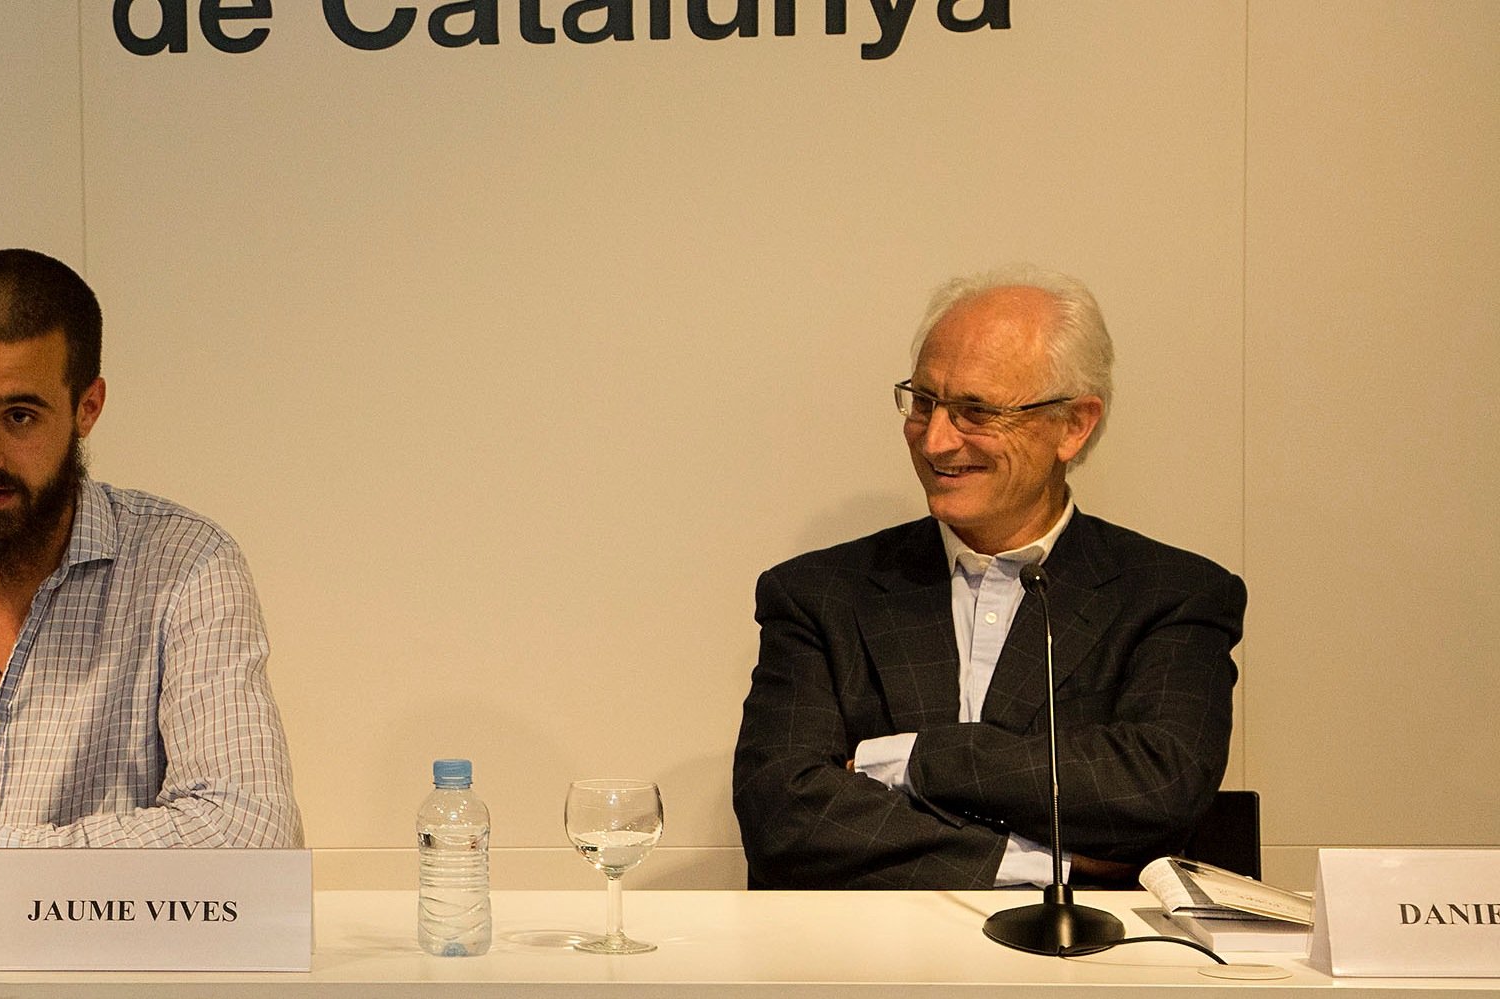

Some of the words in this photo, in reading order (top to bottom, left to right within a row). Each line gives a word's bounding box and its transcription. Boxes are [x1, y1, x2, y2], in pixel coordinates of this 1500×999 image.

[27, 900, 136, 922] JAUME
[146, 900, 238, 922] VIVES
[1398, 903, 1500, 925] DANIE
